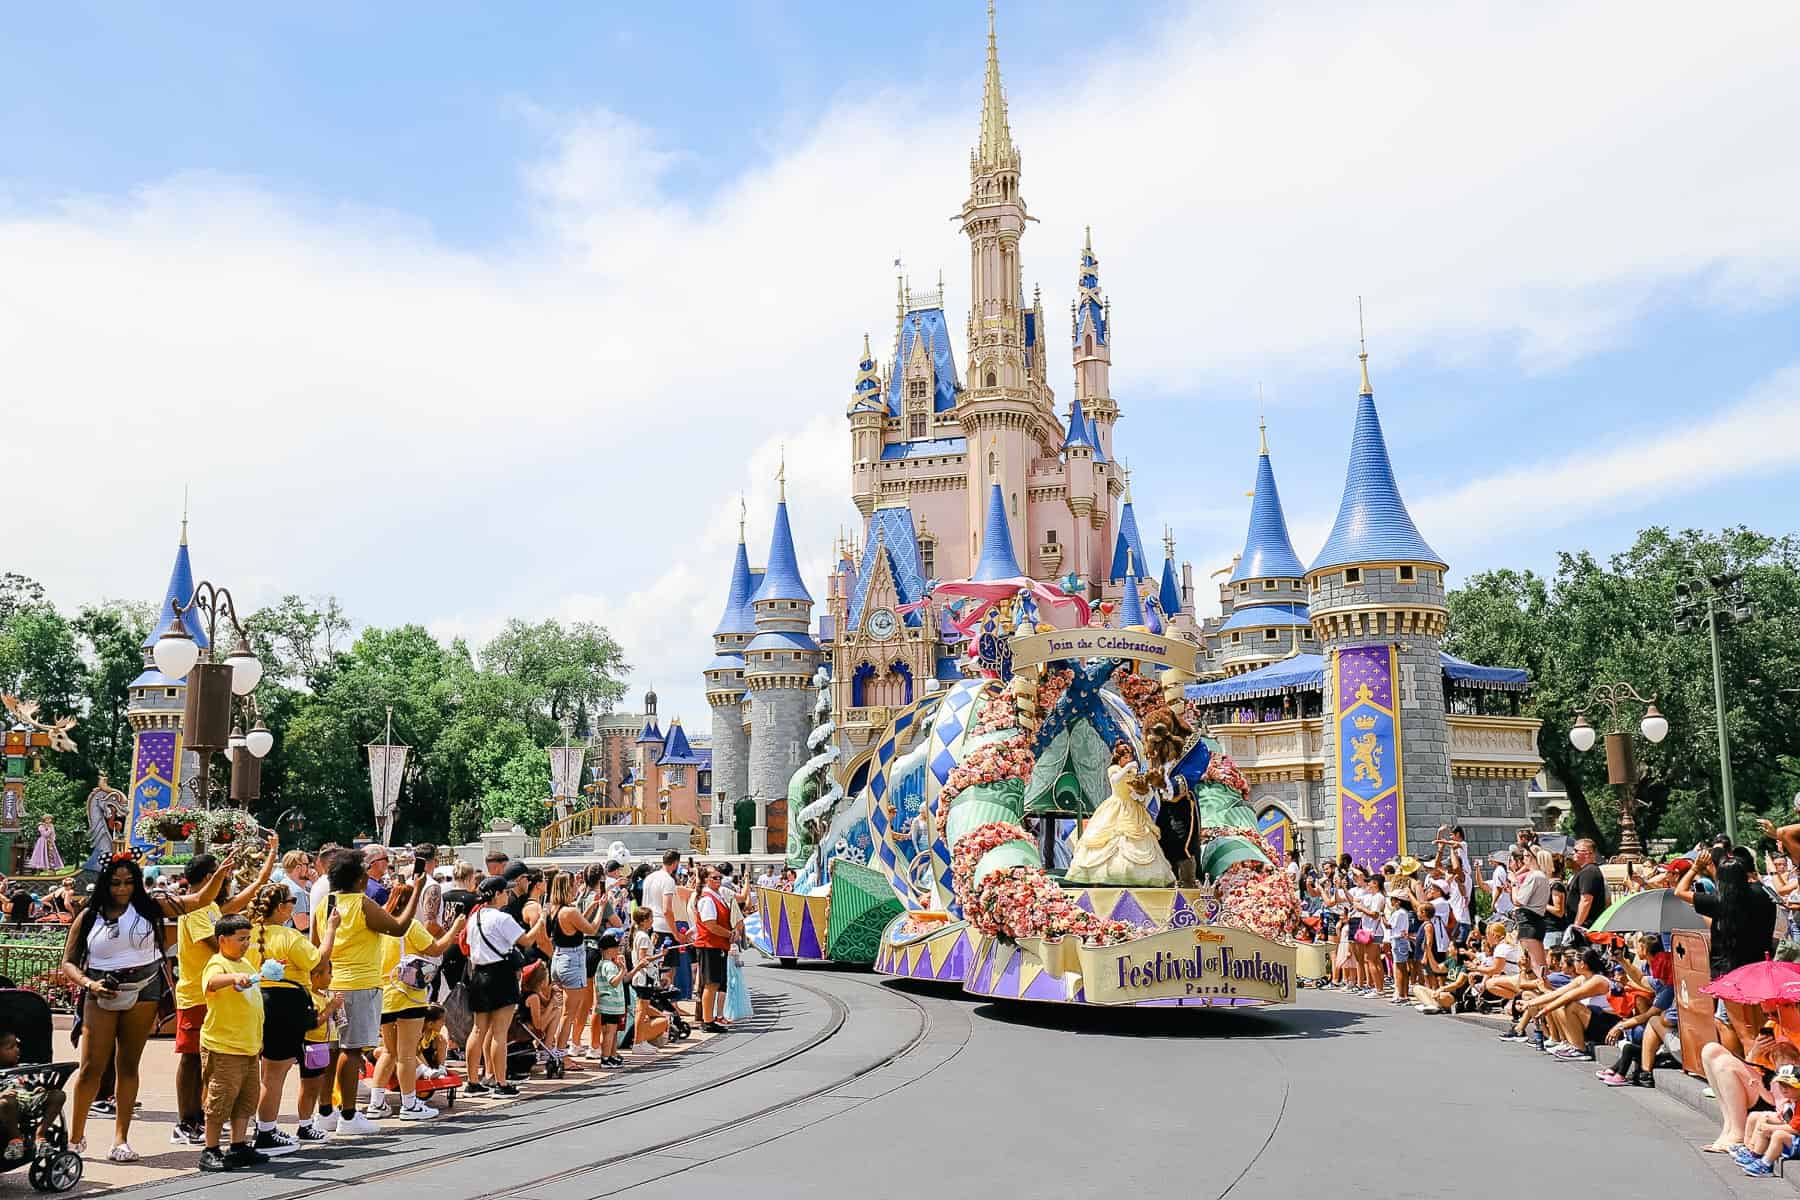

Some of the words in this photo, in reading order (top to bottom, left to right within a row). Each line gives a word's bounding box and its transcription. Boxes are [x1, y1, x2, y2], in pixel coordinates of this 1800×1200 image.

[1048, 639, 1073, 654] Join
[1078, 639, 1092, 649] the
[1097, 637, 1168, 655] Celebration!
[1116, 945, 1202, 989] Festival
[1217, 945, 1289, 1000] Fantasy
[1185, 983, 1238, 995] Parade
